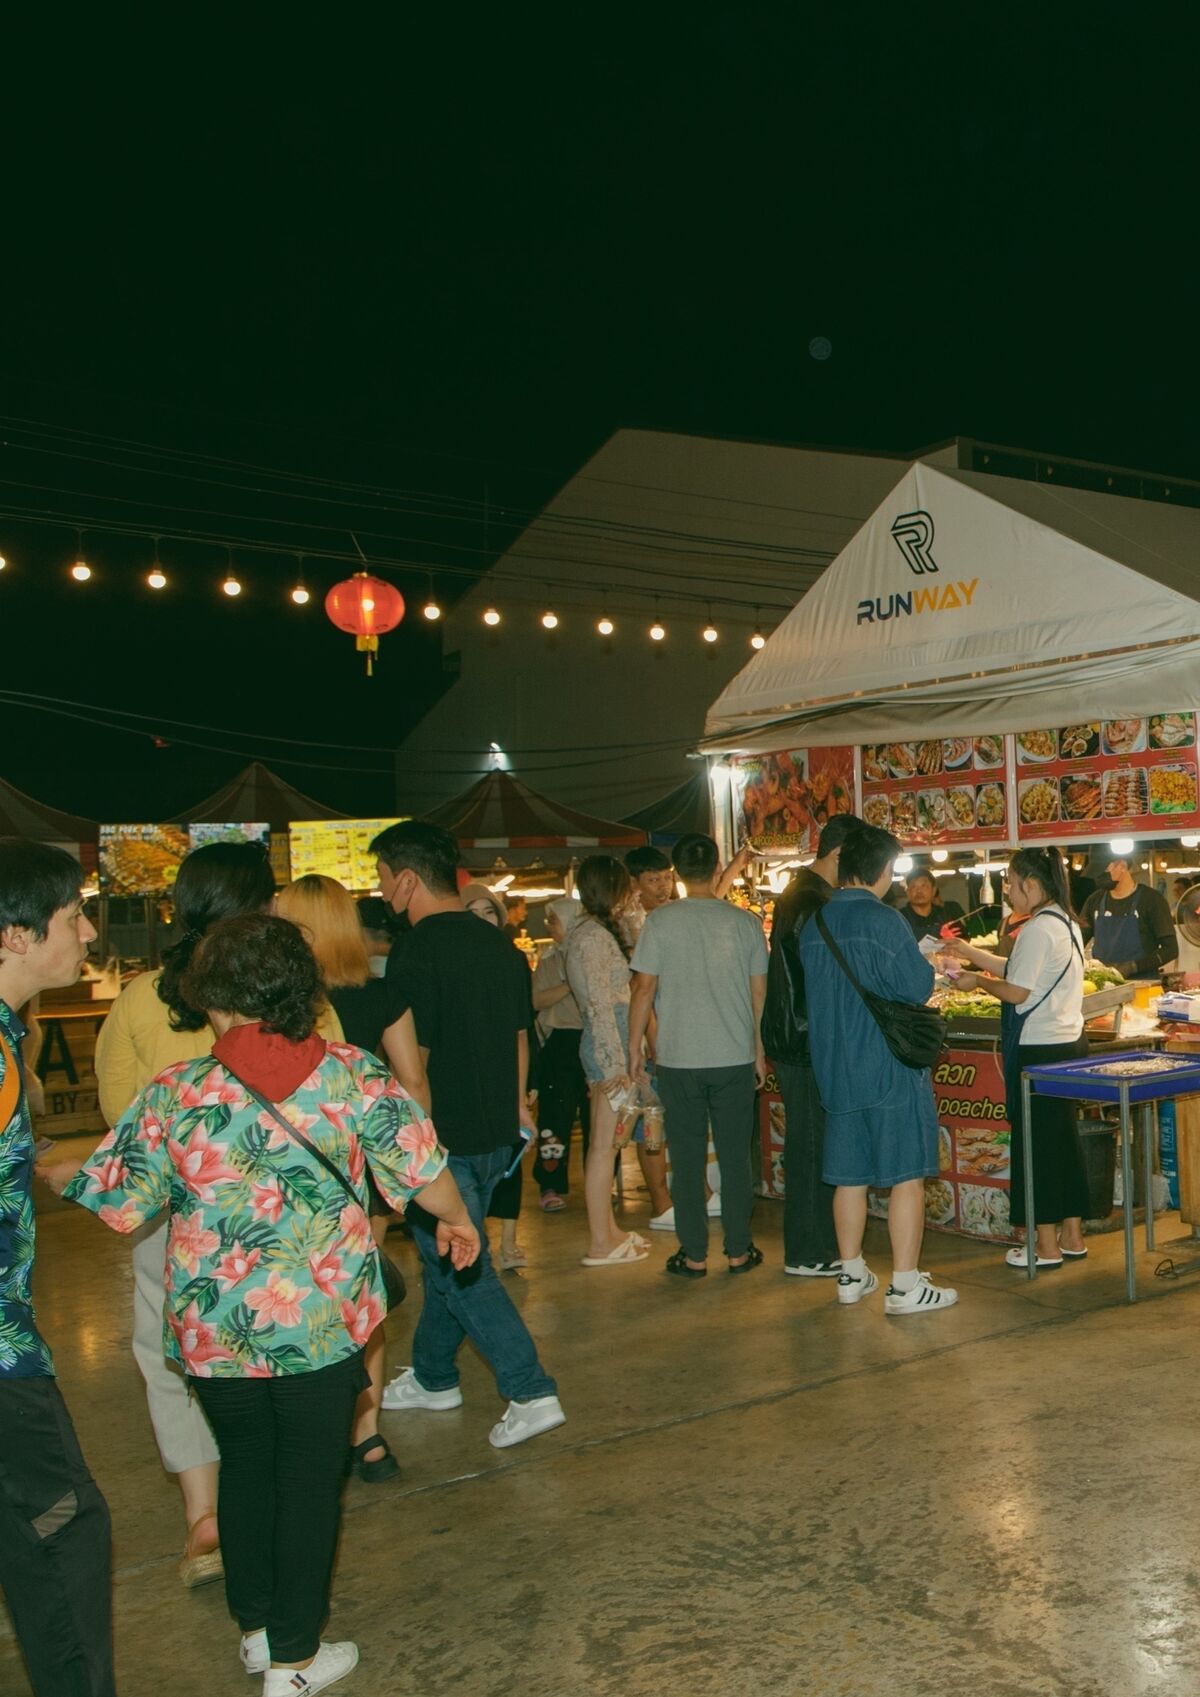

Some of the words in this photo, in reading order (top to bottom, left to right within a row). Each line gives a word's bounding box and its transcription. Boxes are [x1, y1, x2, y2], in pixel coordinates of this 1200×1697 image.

[857, 577, 979, 625] RUNWAY
[53, 1092, 77, 1114] BY
[937, 1097, 1008, 1120] poache
